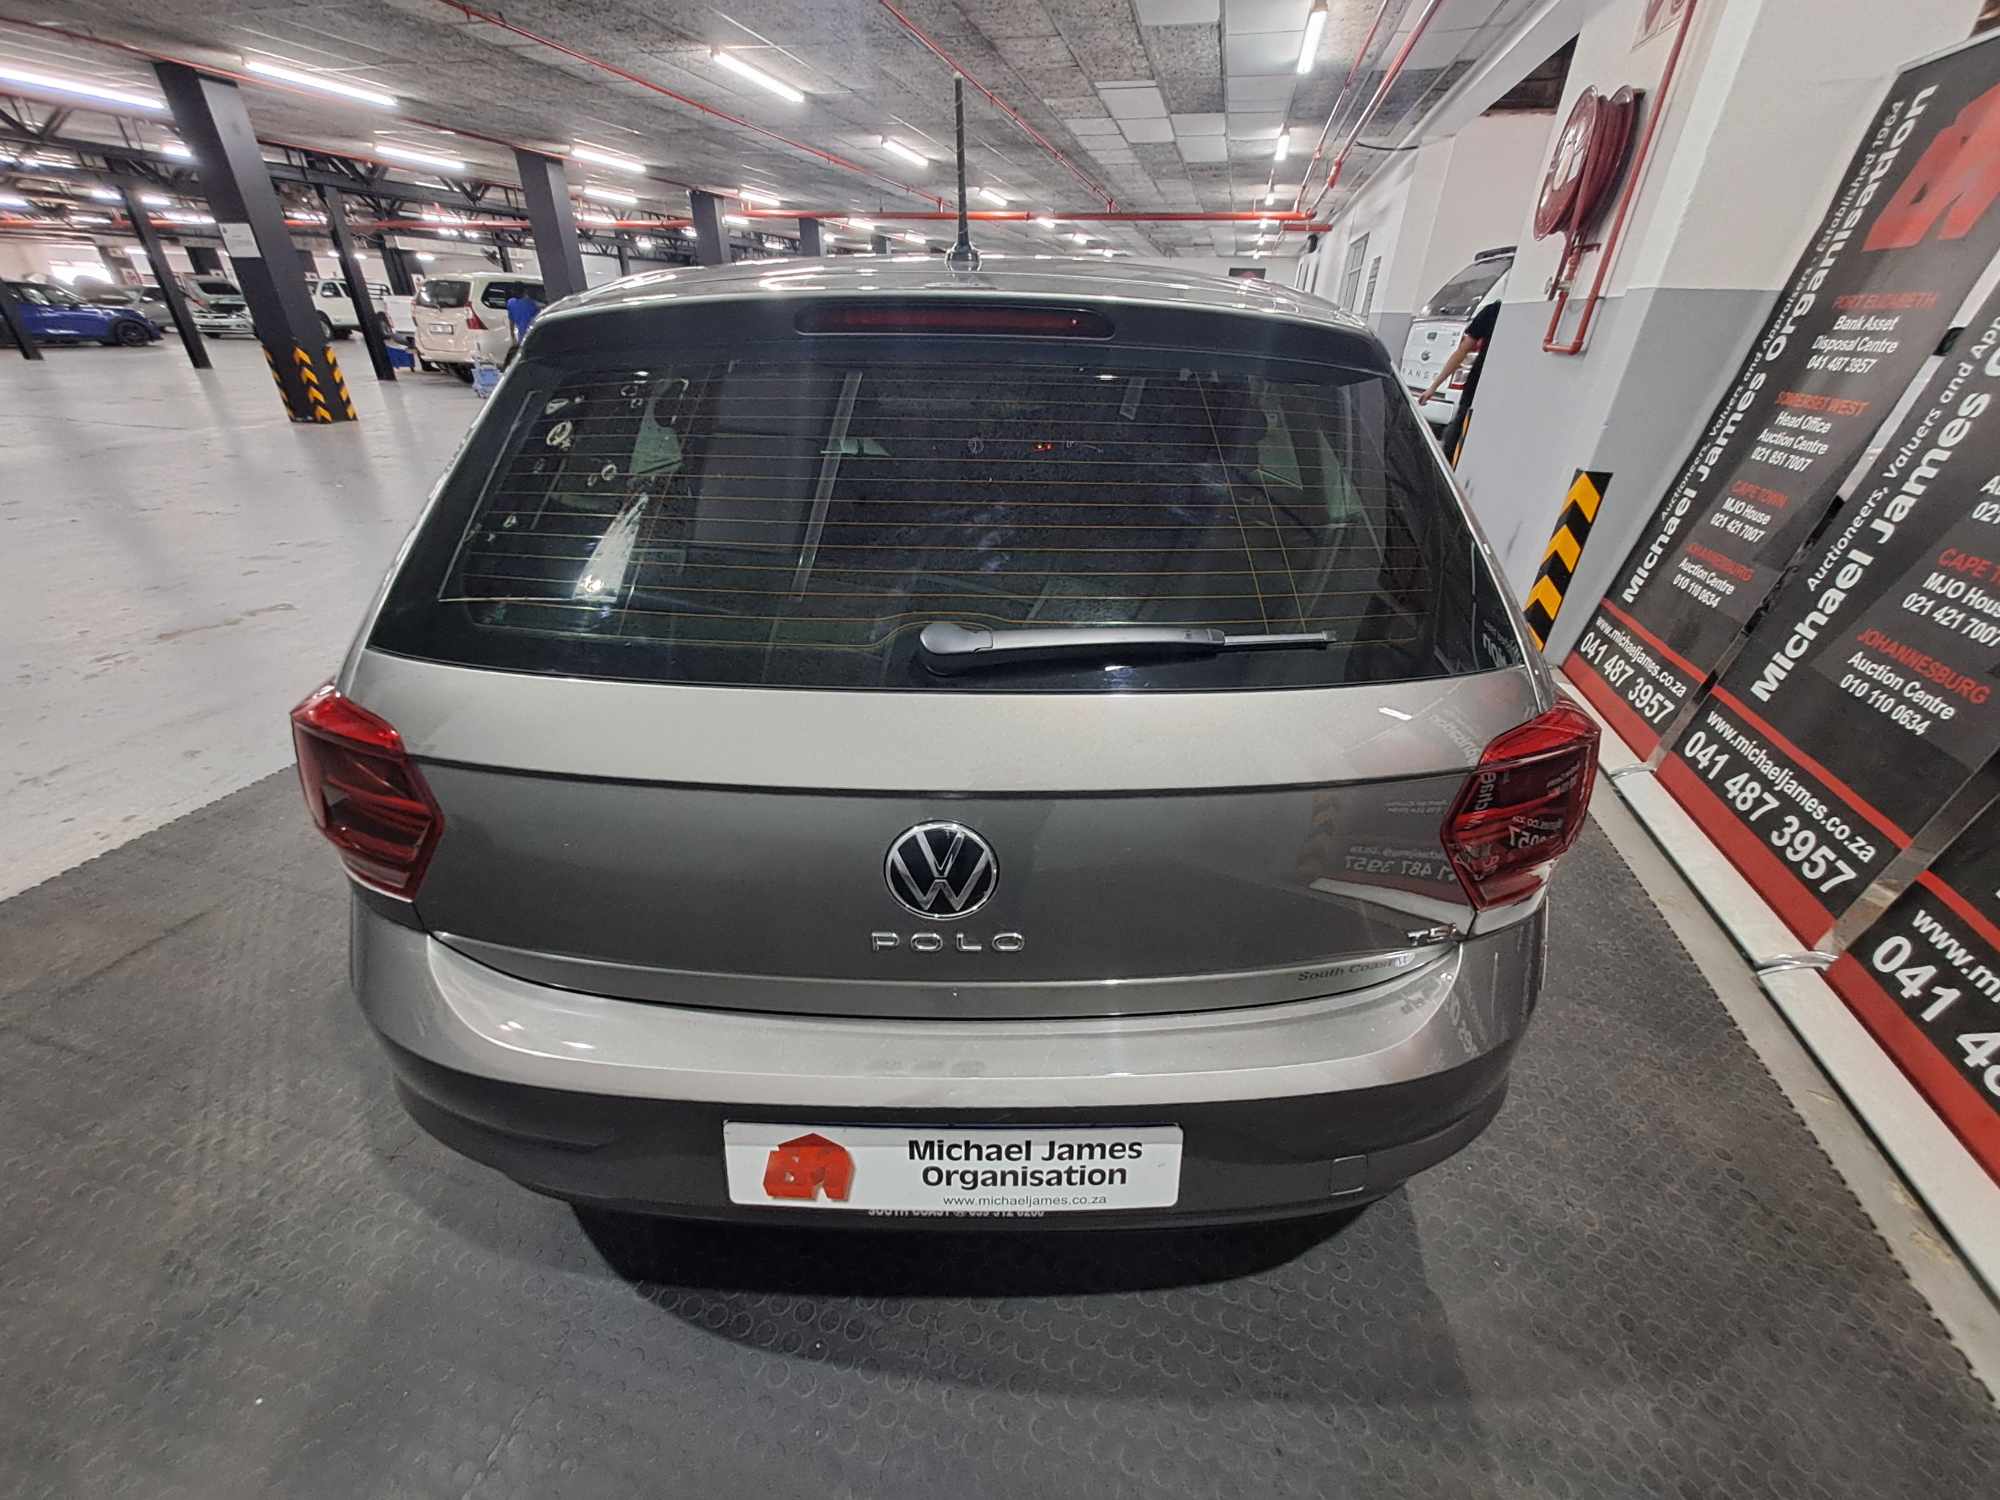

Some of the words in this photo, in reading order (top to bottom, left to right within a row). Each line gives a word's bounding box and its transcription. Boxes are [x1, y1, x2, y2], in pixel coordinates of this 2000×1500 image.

[1743, 351, 1763, 382] and
[1872, 100, 1905, 151] 1964
[1833, 315, 1864, 331] Bank
[1863, 315, 1900, 332] Asset
[1623, 487, 1698, 603] Michael
[1697, 373, 1767, 482] James
[1765, 84, 1939, 361] Organisation
[1811, 336, 1861, 353] Disposal
[1856, 337, 1899, 354] Centre
[1806, 355, 1828, 370] 041
[1845, 357, 1878, 373] 3957
[1774, 411, 1804, 428] Head
[1801, 415, 1832, 433] Office
[1751, 447, 1771, 462] 021
[1757, 429, 1795, 449] Auction
[1793, 435, 1830, 455] Centre
[1807, 487, 1889, 592] Auctioneers,
[1882, 408, 1943, 478] Valuers
[1940, 362, 1974, 404] and
[1722, 497, 1746, 513] MJO
[1742, 504, 1771, 525] House
[1710, 513, 1729, 528] 021
[1740, 524, 1766, 543] 7007
[1750, 549, 1874, 702] Michael
[1870, 392, 1991, 544] James
[1678, 558, 1709, 580] Auction
[1706, 571, 1735, 595] Centre
[1938, 548, 1992, 577] CAPE
[1673, 574, 1690, 590] 010
[1922, 572, 1966, 599] MJO
[1902, 592, 1936, 616] 021
[1932, 606, 1966, 630] 421
[1595, 616, 1688, 698] www.michaeljames.co.za
[1856, 628, 1991, 704] JOHANNESBURG
[1580, 632, 1608, 665] 041
[1603, 655, 1635, 687] 487
[1628, 677, 1676, 724] 3957
[1847, 651, 1905, 690] Auction
[1903, 681, 1955, 720] Centre
[1840, 674, 1870, 697] 010
[1867, 690, 1895, 713] 110
[1891, 705, 1931, 735] 0634
[1705, 710, 1876, 863] www.michaeljames.co.za
[1684, 731, 1730, 780] 041
[1724, 772, 1780, 822] 487
[1770, 815, 1857, 893] 3957
[872, 932, 1025, 951] POLO
[1297, 968, 1345, 982] South
[1871, 935, 1962, 1023] 041
[908, 1140, 1031, 1160] Michael
[1042, 1140, 1143, 1161] James
[922, 1165, 1127, 1190] Organisation
[943, 1195, 1107, 1208] www.michaeljames.co.za
